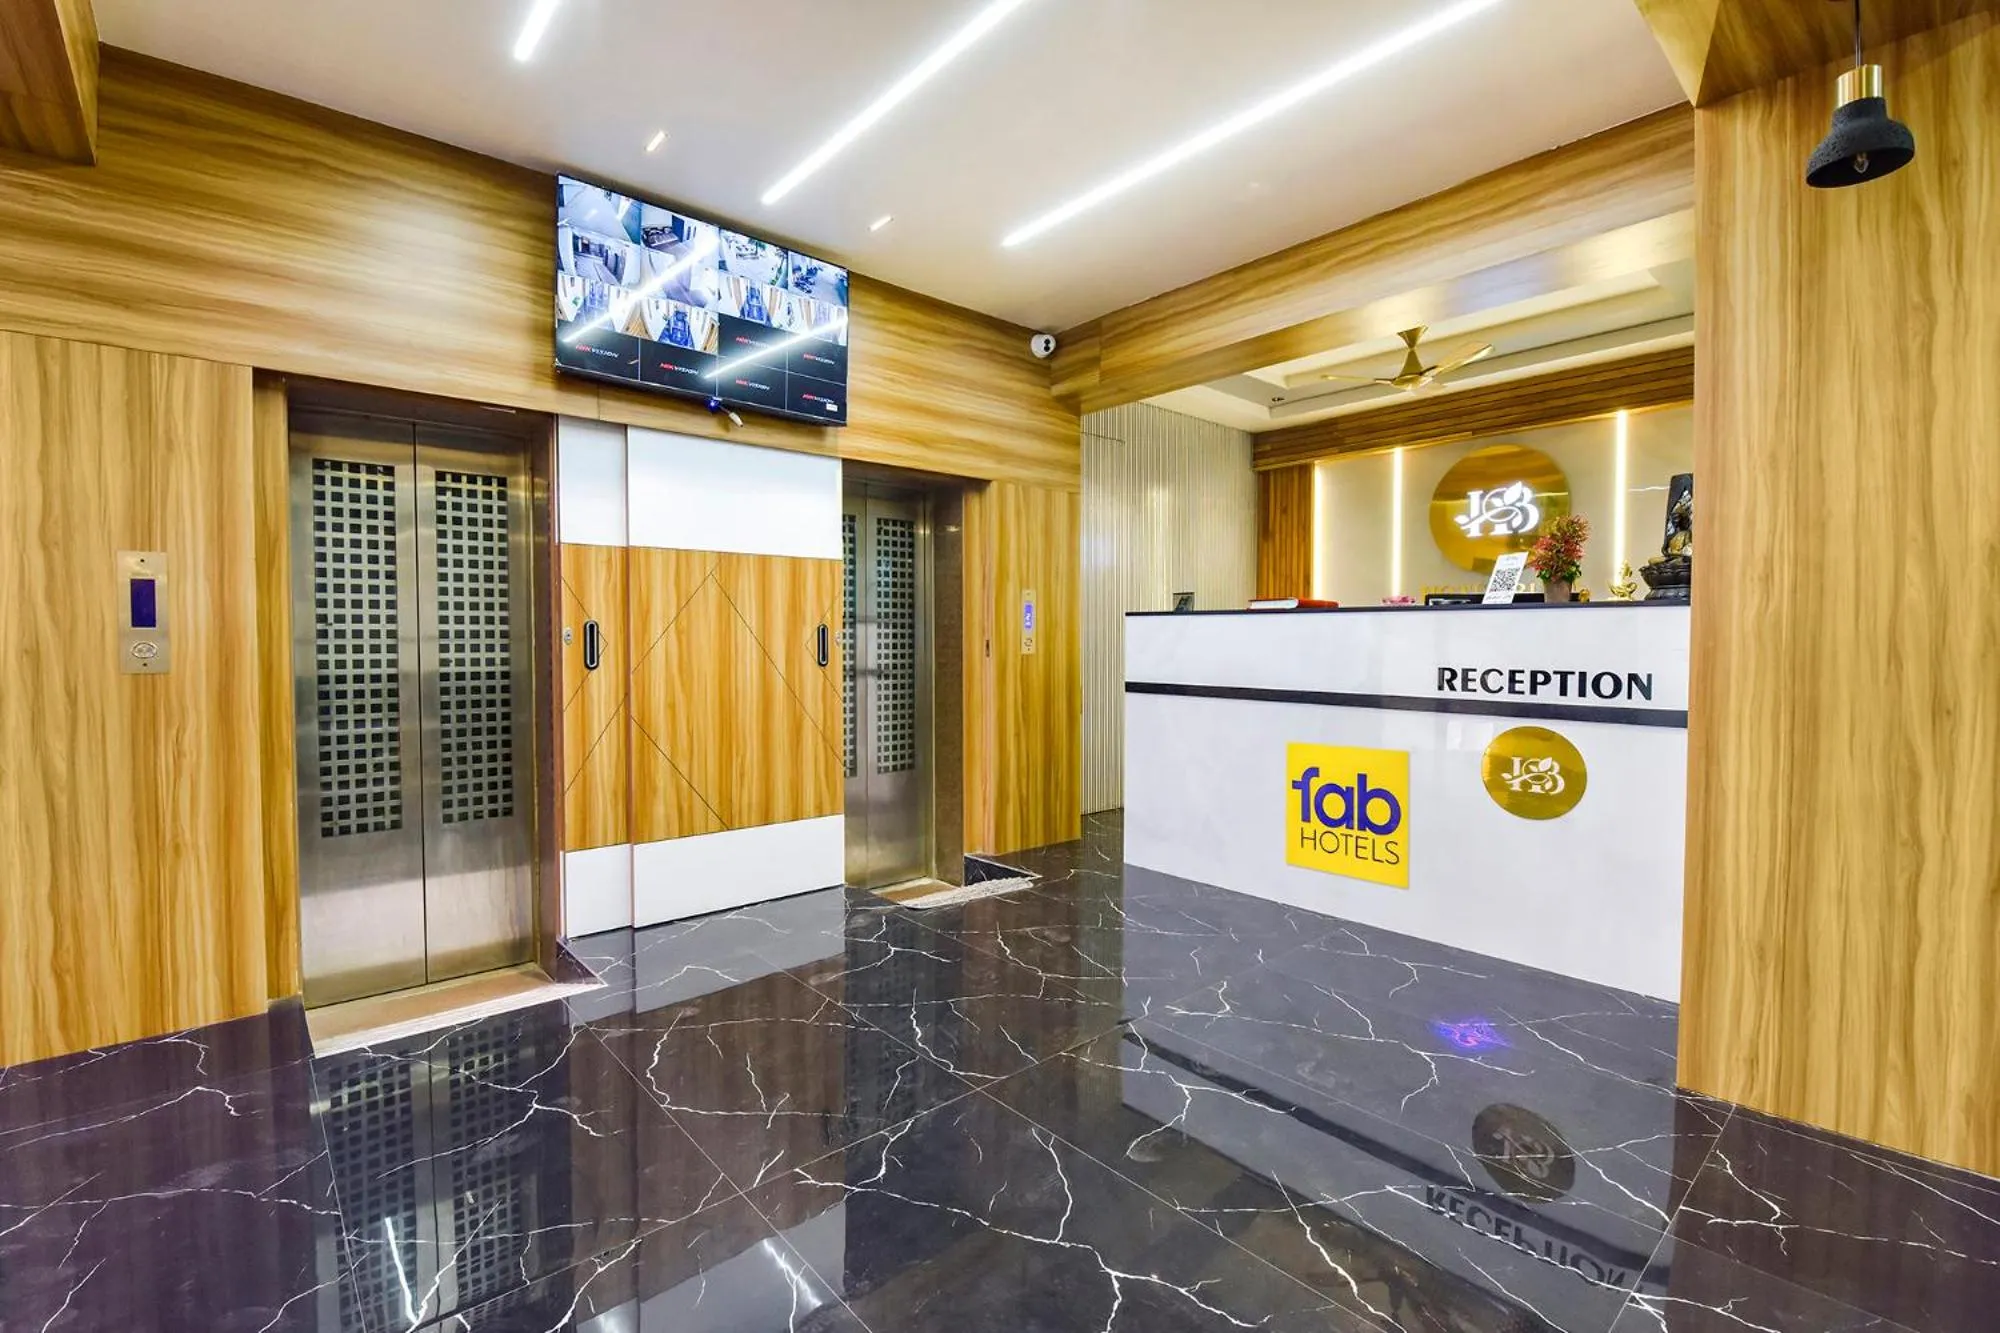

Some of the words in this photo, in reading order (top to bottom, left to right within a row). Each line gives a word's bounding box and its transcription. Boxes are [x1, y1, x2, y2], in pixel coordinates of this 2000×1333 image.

[1437, 666, 1653, 701] RECEPTION
[1291, 766, 1402, 836] fab
[1300, 827, 1401, 866] HOTELS
